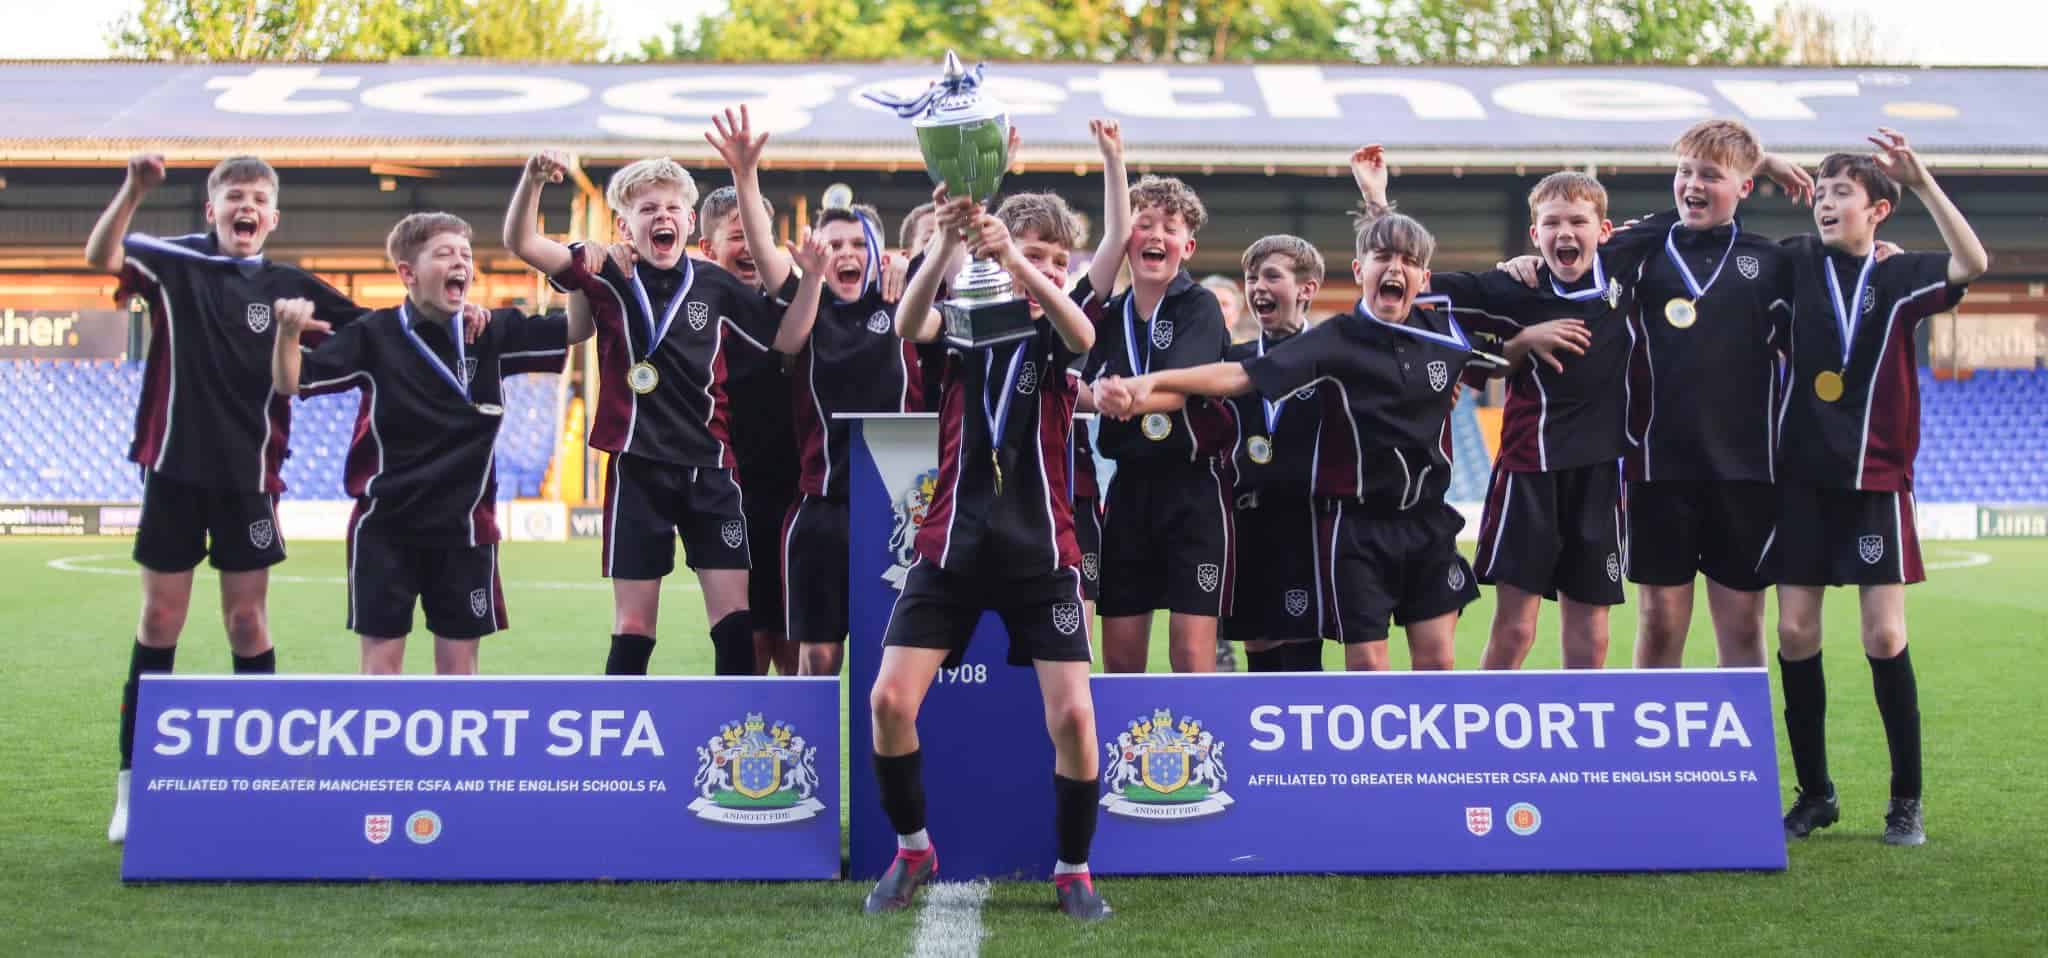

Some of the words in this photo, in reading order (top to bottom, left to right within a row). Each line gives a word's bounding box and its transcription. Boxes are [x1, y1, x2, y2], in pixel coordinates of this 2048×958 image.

[0, 308, 79, 347] her.
[153, 709, 529, 757] STOCKPORT
[546, 709, 665, 757] SFA
[1248, 702, 1615, 752] STOCKPORT
[1633, 701, 1753, 749] SFA
[147, 778, 229, 792] AFFILIATED
[231, 779, 249, 792] TO
[251, 779, 317, 792] GREATER
[319, 779, 414, 792] MANCHESTER
[416, 779, 452, 792] CSFA
[454, 779, 485, 792] AND
[487, 779, 516, 792] THE
[518, 779, 579, 792] ENGLISH
[582, 779, 646, 792] SCHOOLS
[648, 779, 667, 792] FA
[1247, 773, 1327, 786] AFFILIATED
[1329, 773, 1348, 786] TO
[1350, 772, 1414, 786] GREATER
[1416, 772, 1510, 785] MANCHESTER
[1512, 771, 1547, 785] CSFA
[1549, 771, 1580, 784] AND
[1581, 771, 1609, 784] THE
[1611, 770, 1672, 784] ENGLISH
[1674, 770, 1737, 783] SCHOOLS
[1739, 770, 1758, 783] FA
